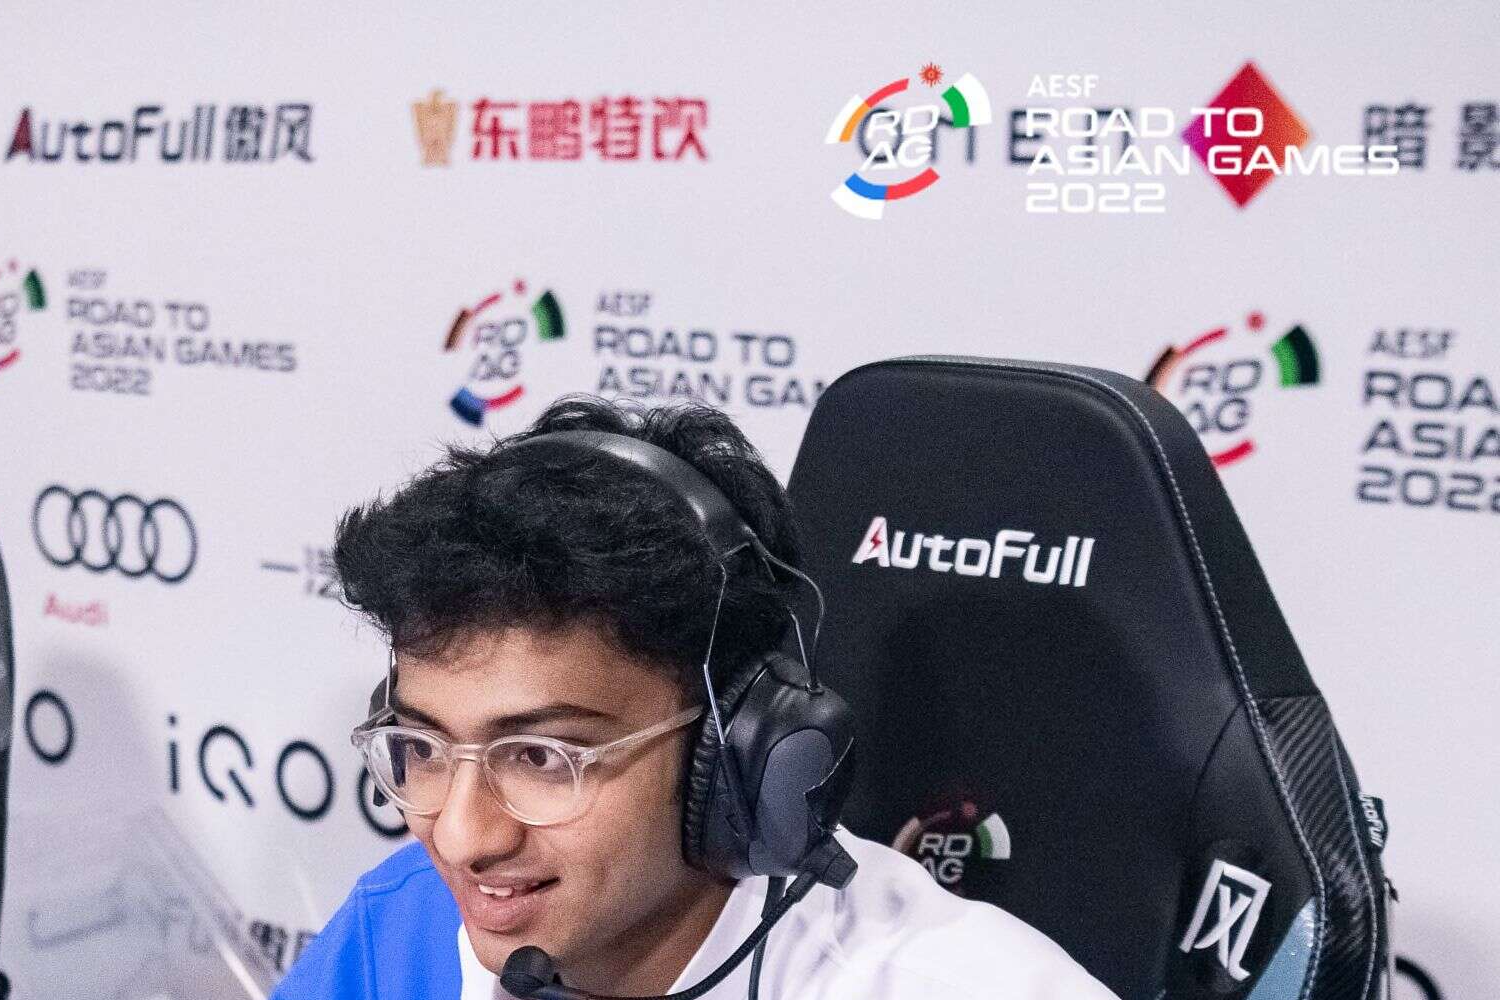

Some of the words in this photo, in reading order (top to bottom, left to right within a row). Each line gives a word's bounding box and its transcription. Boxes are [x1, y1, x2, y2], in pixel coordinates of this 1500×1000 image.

[594, 325, 718, 363] ROAD
[732, 333, 797, 368] TO
[1361, 369, 1500, 413] ROA
[1359, 419, 1500, 463] ASIA
[1354, 465, 1500, 514] 202
[852, 516, 1096, 588] AutoFull
[1179, 858, 1273, 982] 风
